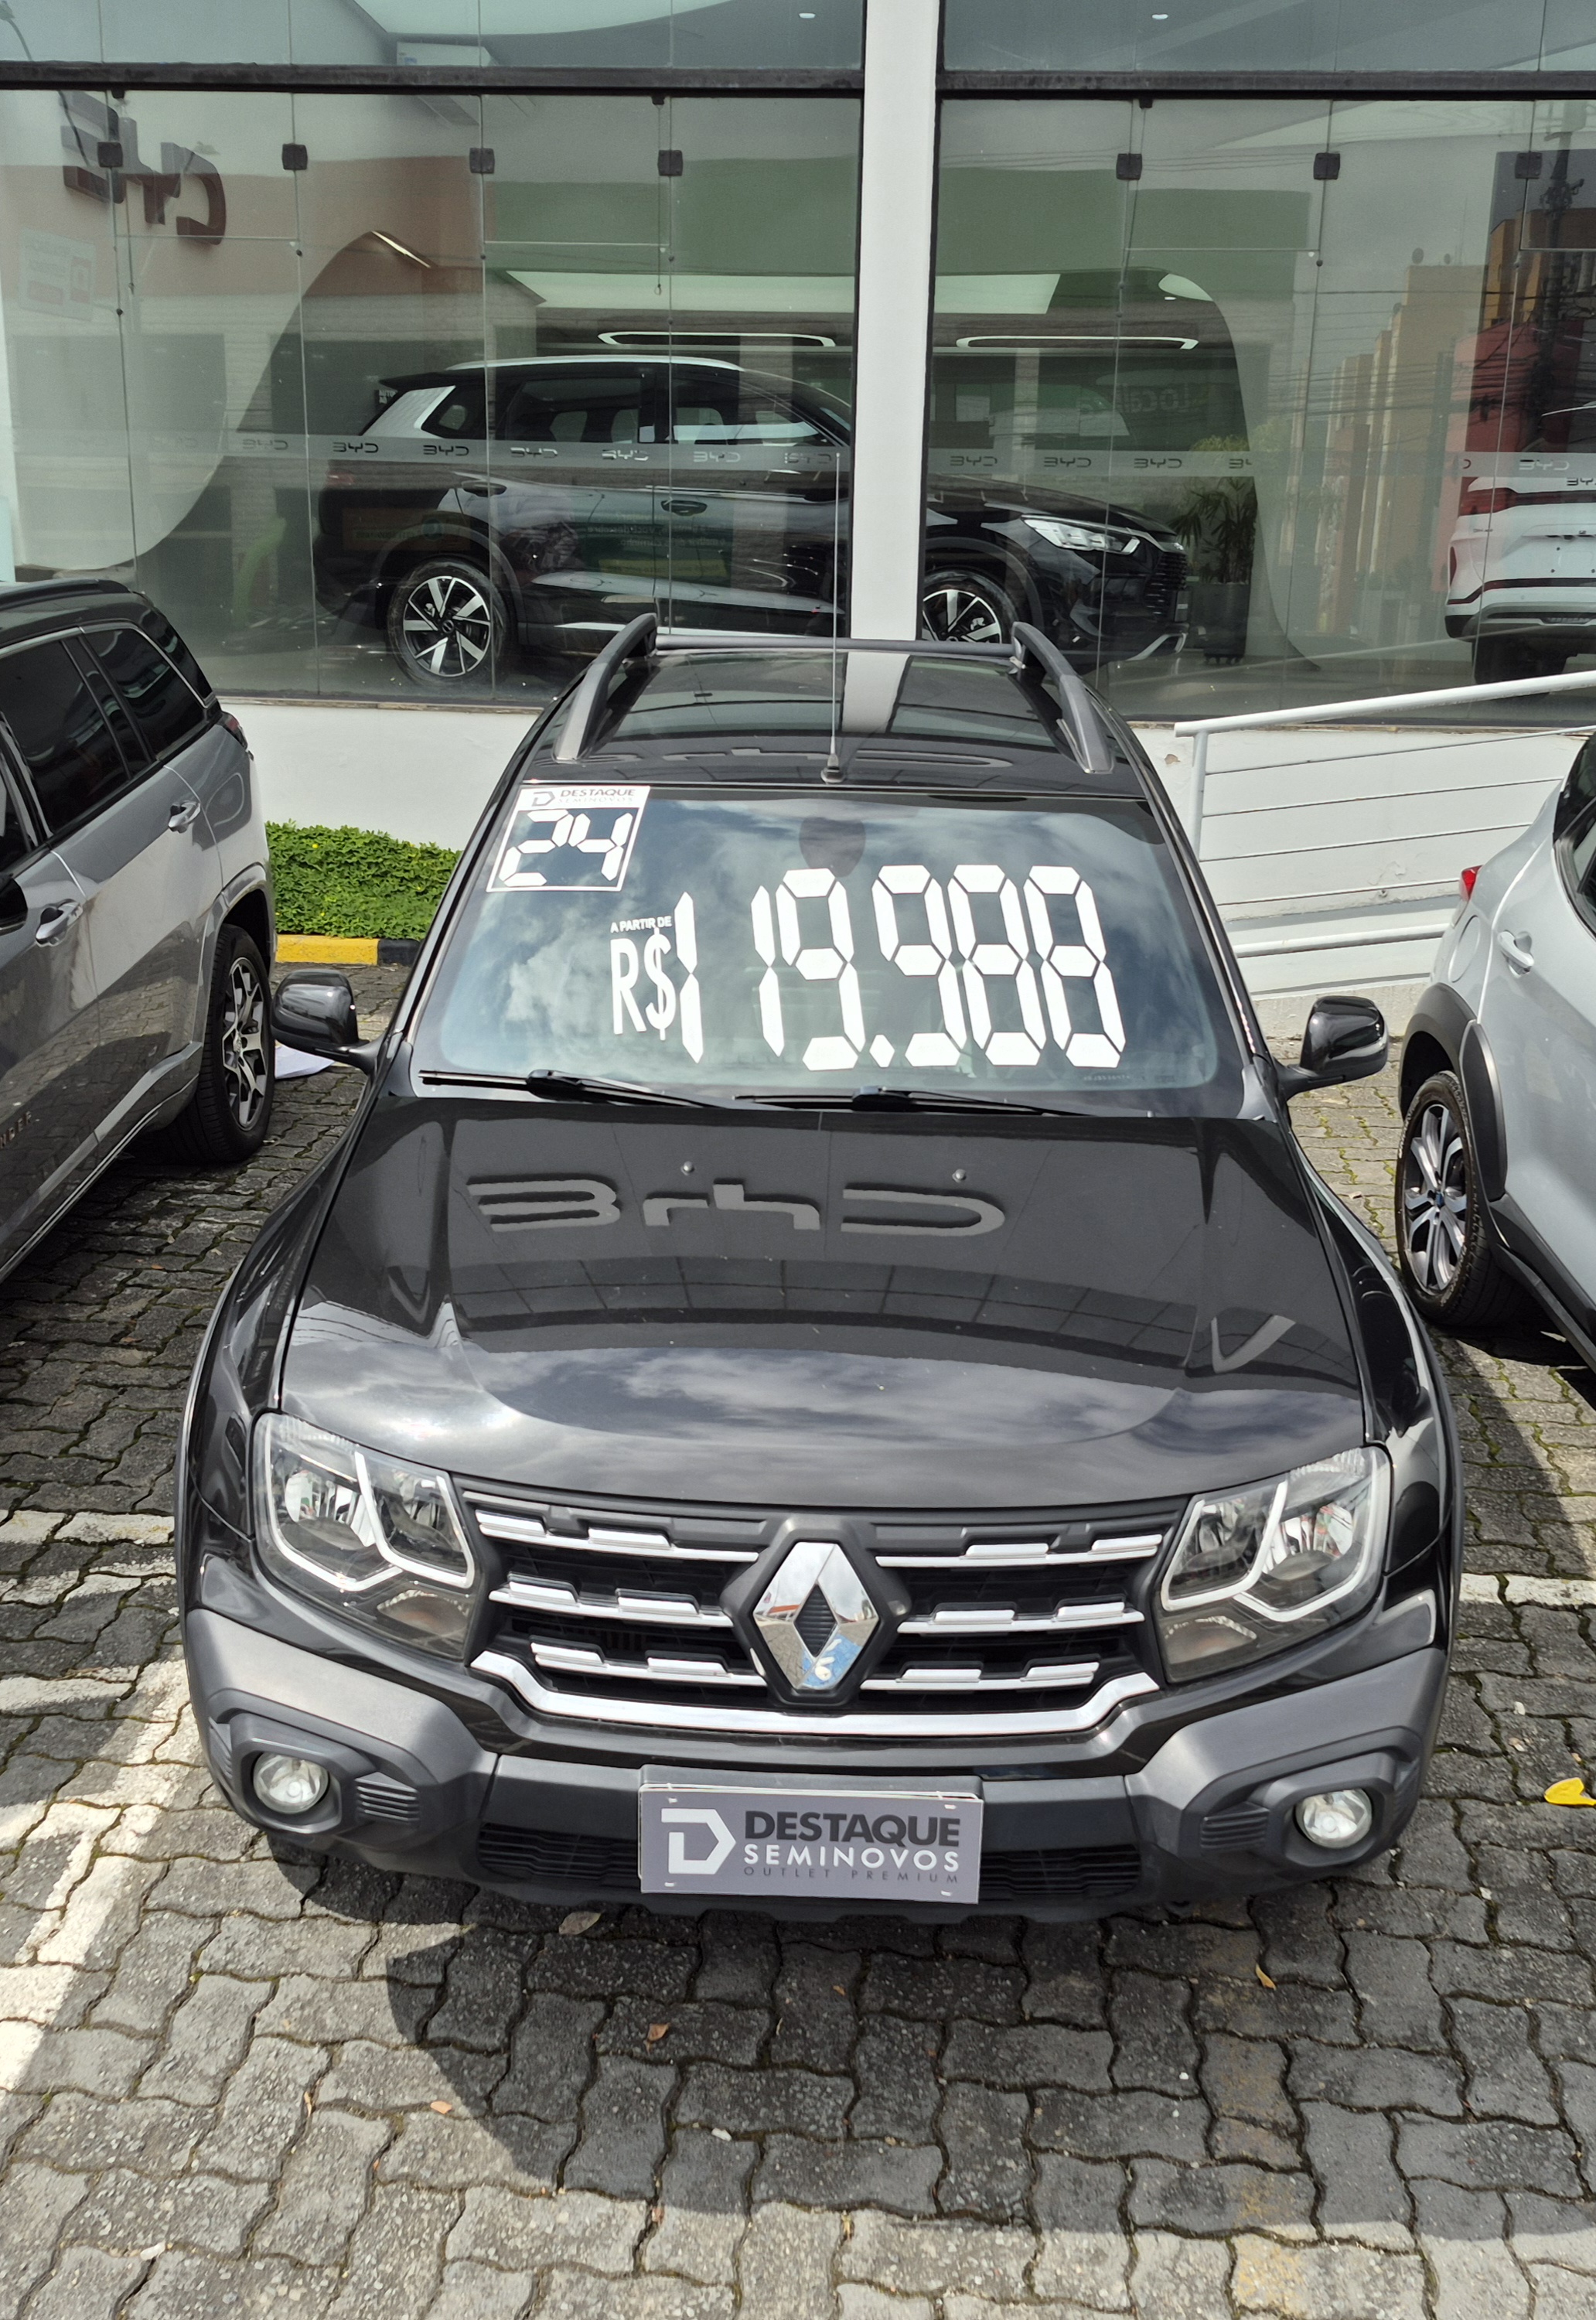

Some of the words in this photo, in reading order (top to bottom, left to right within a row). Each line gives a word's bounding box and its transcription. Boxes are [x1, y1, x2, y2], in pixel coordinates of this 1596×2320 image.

[332, 442, 379, 453] BYD
[423, 445, 469, 455] BYD
[510, 447, 558, 458] BYD
[694, 452, 741, 463] BYD
[950, 455, 998, 467] BYD
[1044, 456, 1092, 469] BYD
[1134, 458, 1182, 469] BYD
[561, 788, 636, 797] DESTAQUE
[498, 809, 633, 887] 24
[610, 922, 619, 933] A
[619, 917, 656, 932] PARTIR
[656, 916, 672, 928] DE
[610, 926, 677, 1041] R$
[745, 1810, 960, 1848] DESTAQUE
[743, 1844, 960, 1872] SEMINOVOS
[743, 1865, 830, 1878] OUTLET
[851, 1870, 958, 1884] PREMIUM
